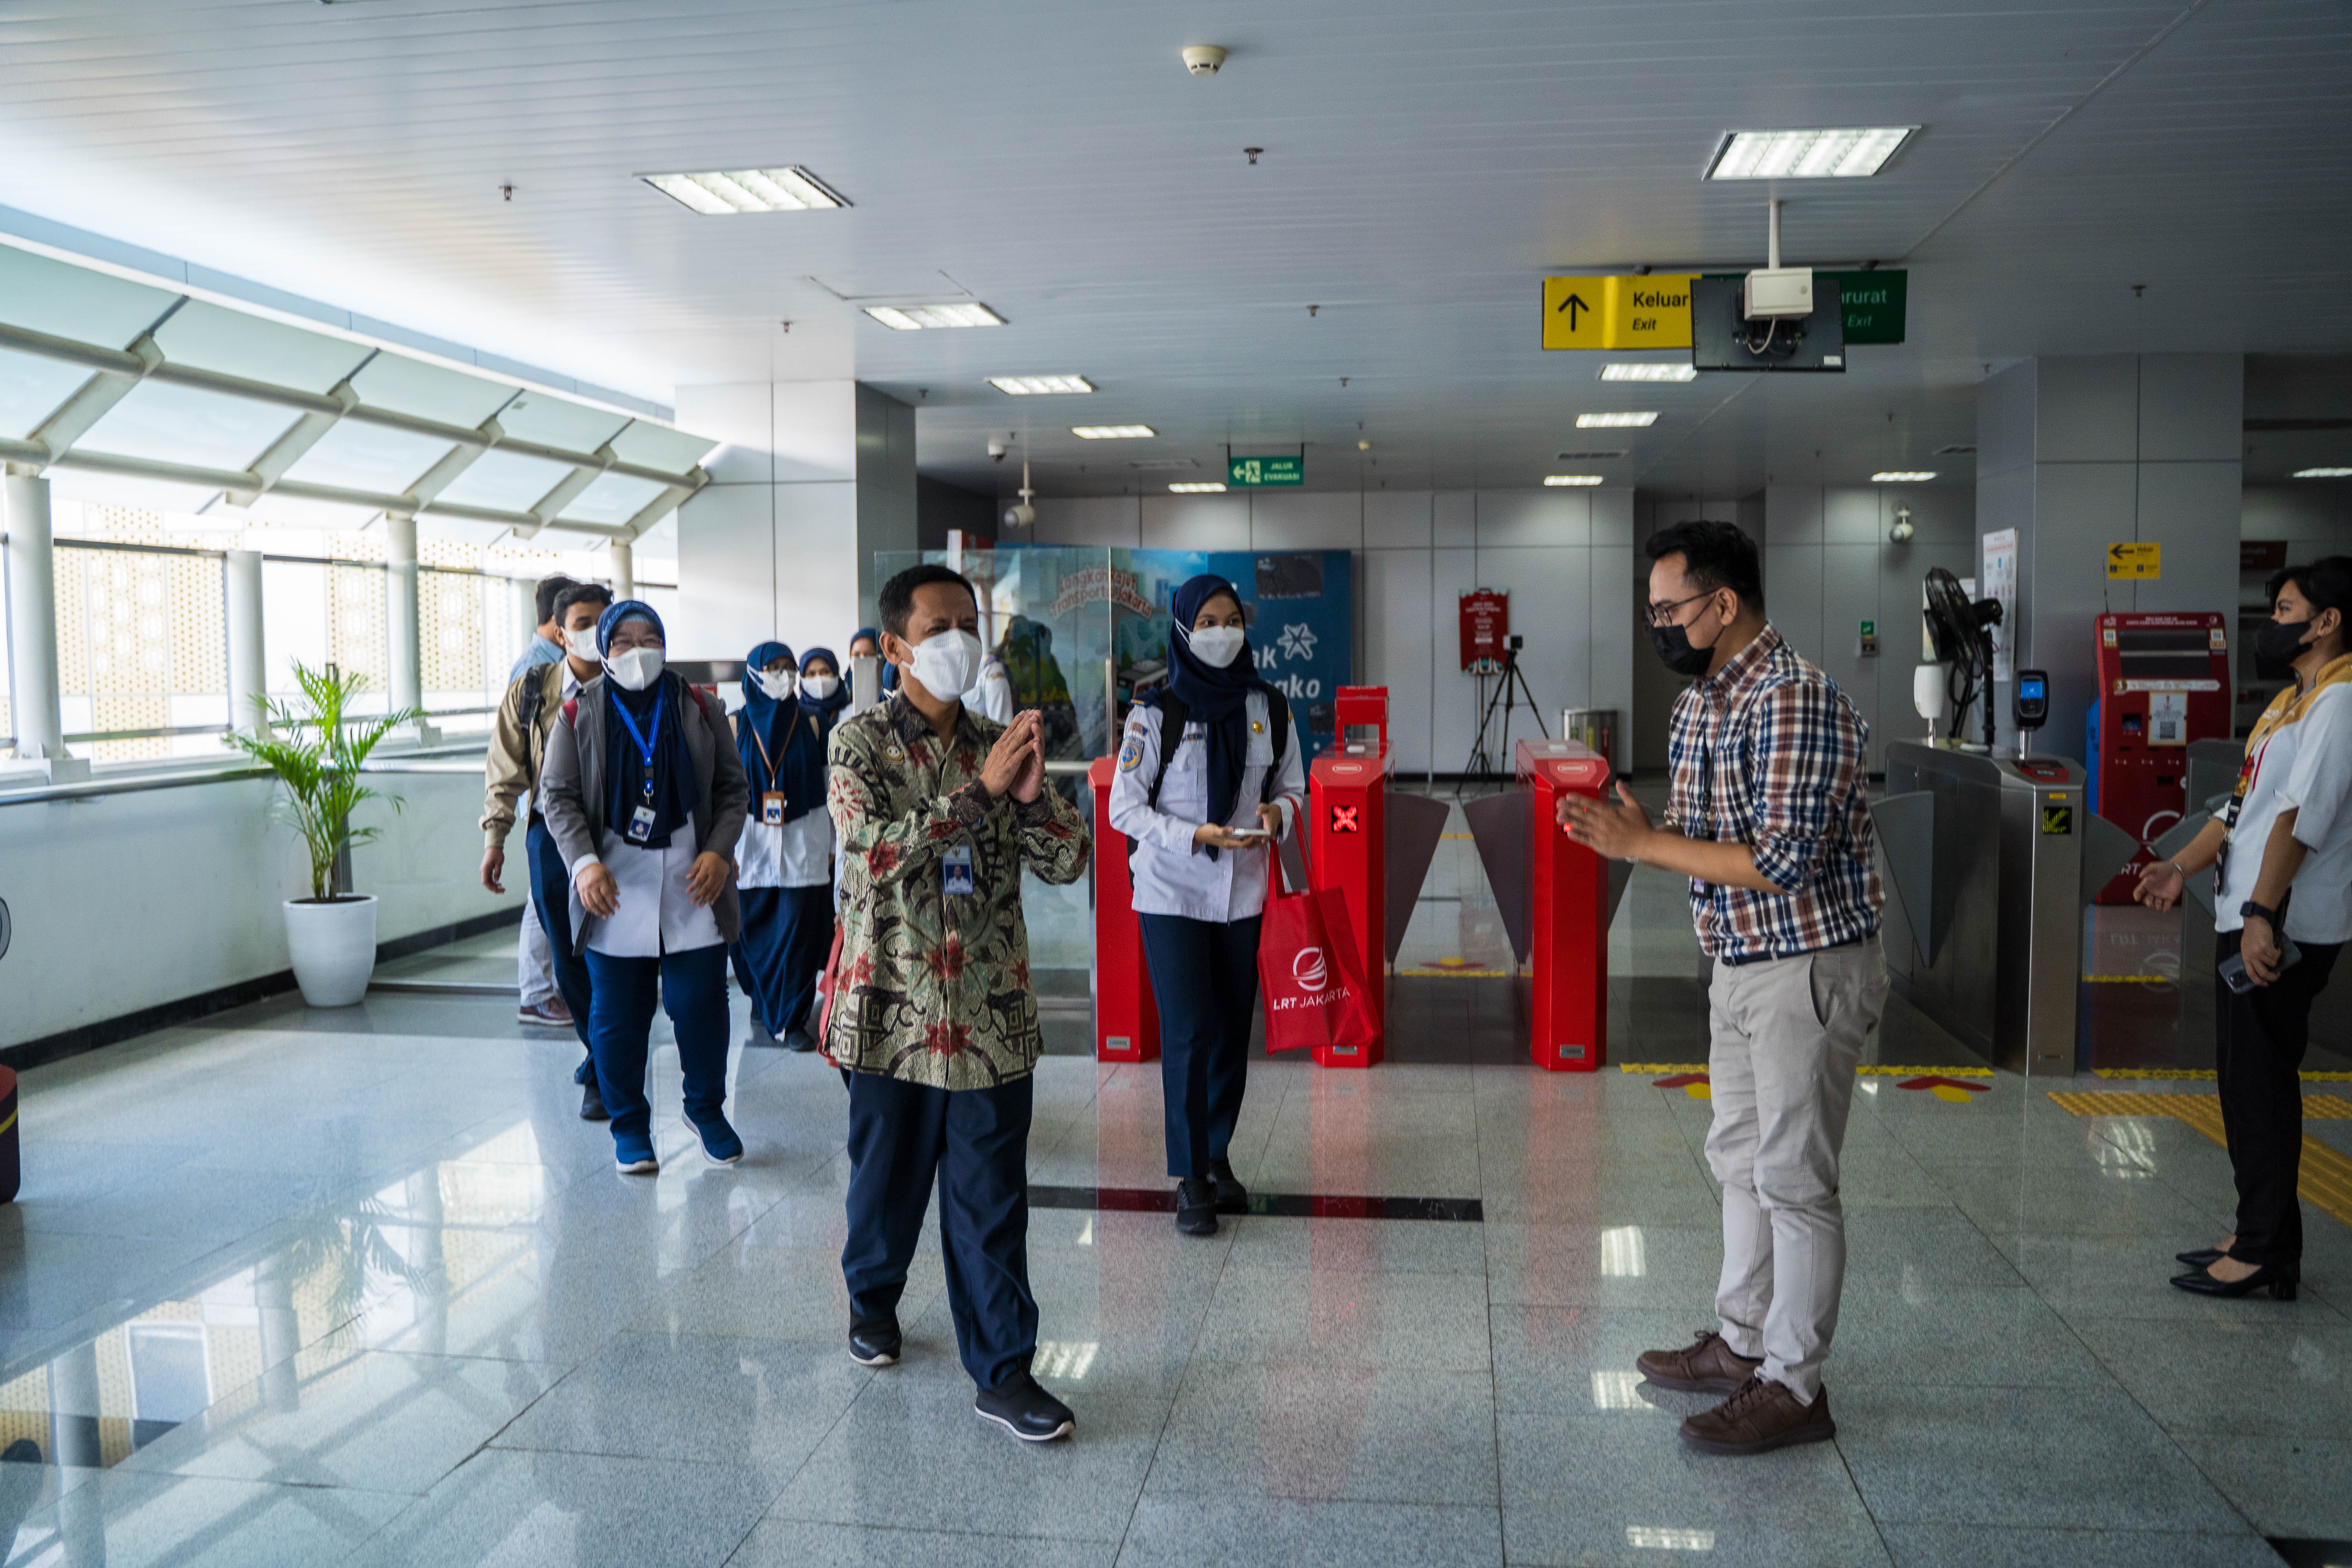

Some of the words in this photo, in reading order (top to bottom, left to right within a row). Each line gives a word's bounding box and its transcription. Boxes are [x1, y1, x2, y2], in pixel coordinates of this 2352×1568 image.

[1633, 291, 1688, 307] Keluar
[1632, 317, 1657, 331] Exit
[1847, 314, 1873, 328] Exit
[1270, 461, 1294, 470] JALUR
[1264, 473, 1300, 482] EVAKUASI
[2118, 862, 2141, 875] RT
[1274, 997, 1297, 1011] LRT
[1300, 986, 1350, 1008] JAKARTA
